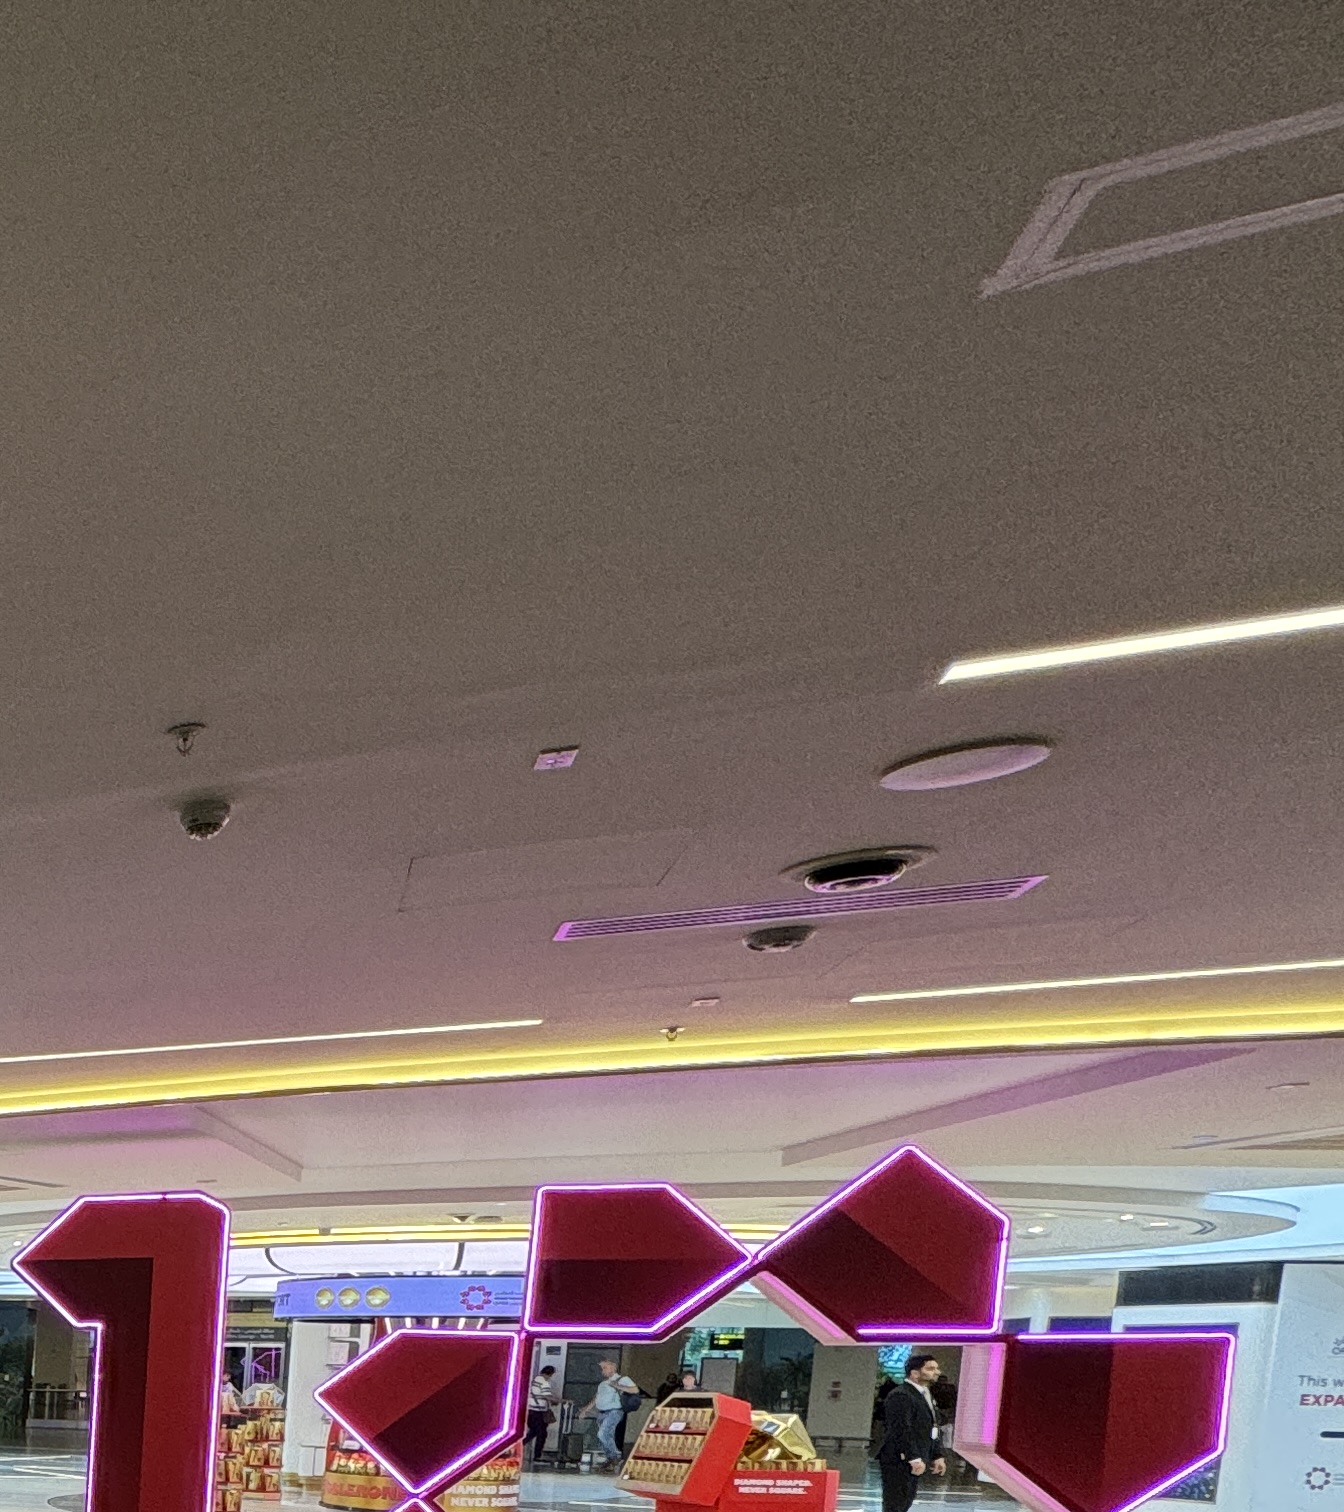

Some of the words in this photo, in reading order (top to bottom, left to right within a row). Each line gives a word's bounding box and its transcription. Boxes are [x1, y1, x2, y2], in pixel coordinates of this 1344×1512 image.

[1298, 1374, 1328, 1388] This
[450, 1485, 498, 1495] IAMOND
[450, 1496, 490, 1507] NEVER
